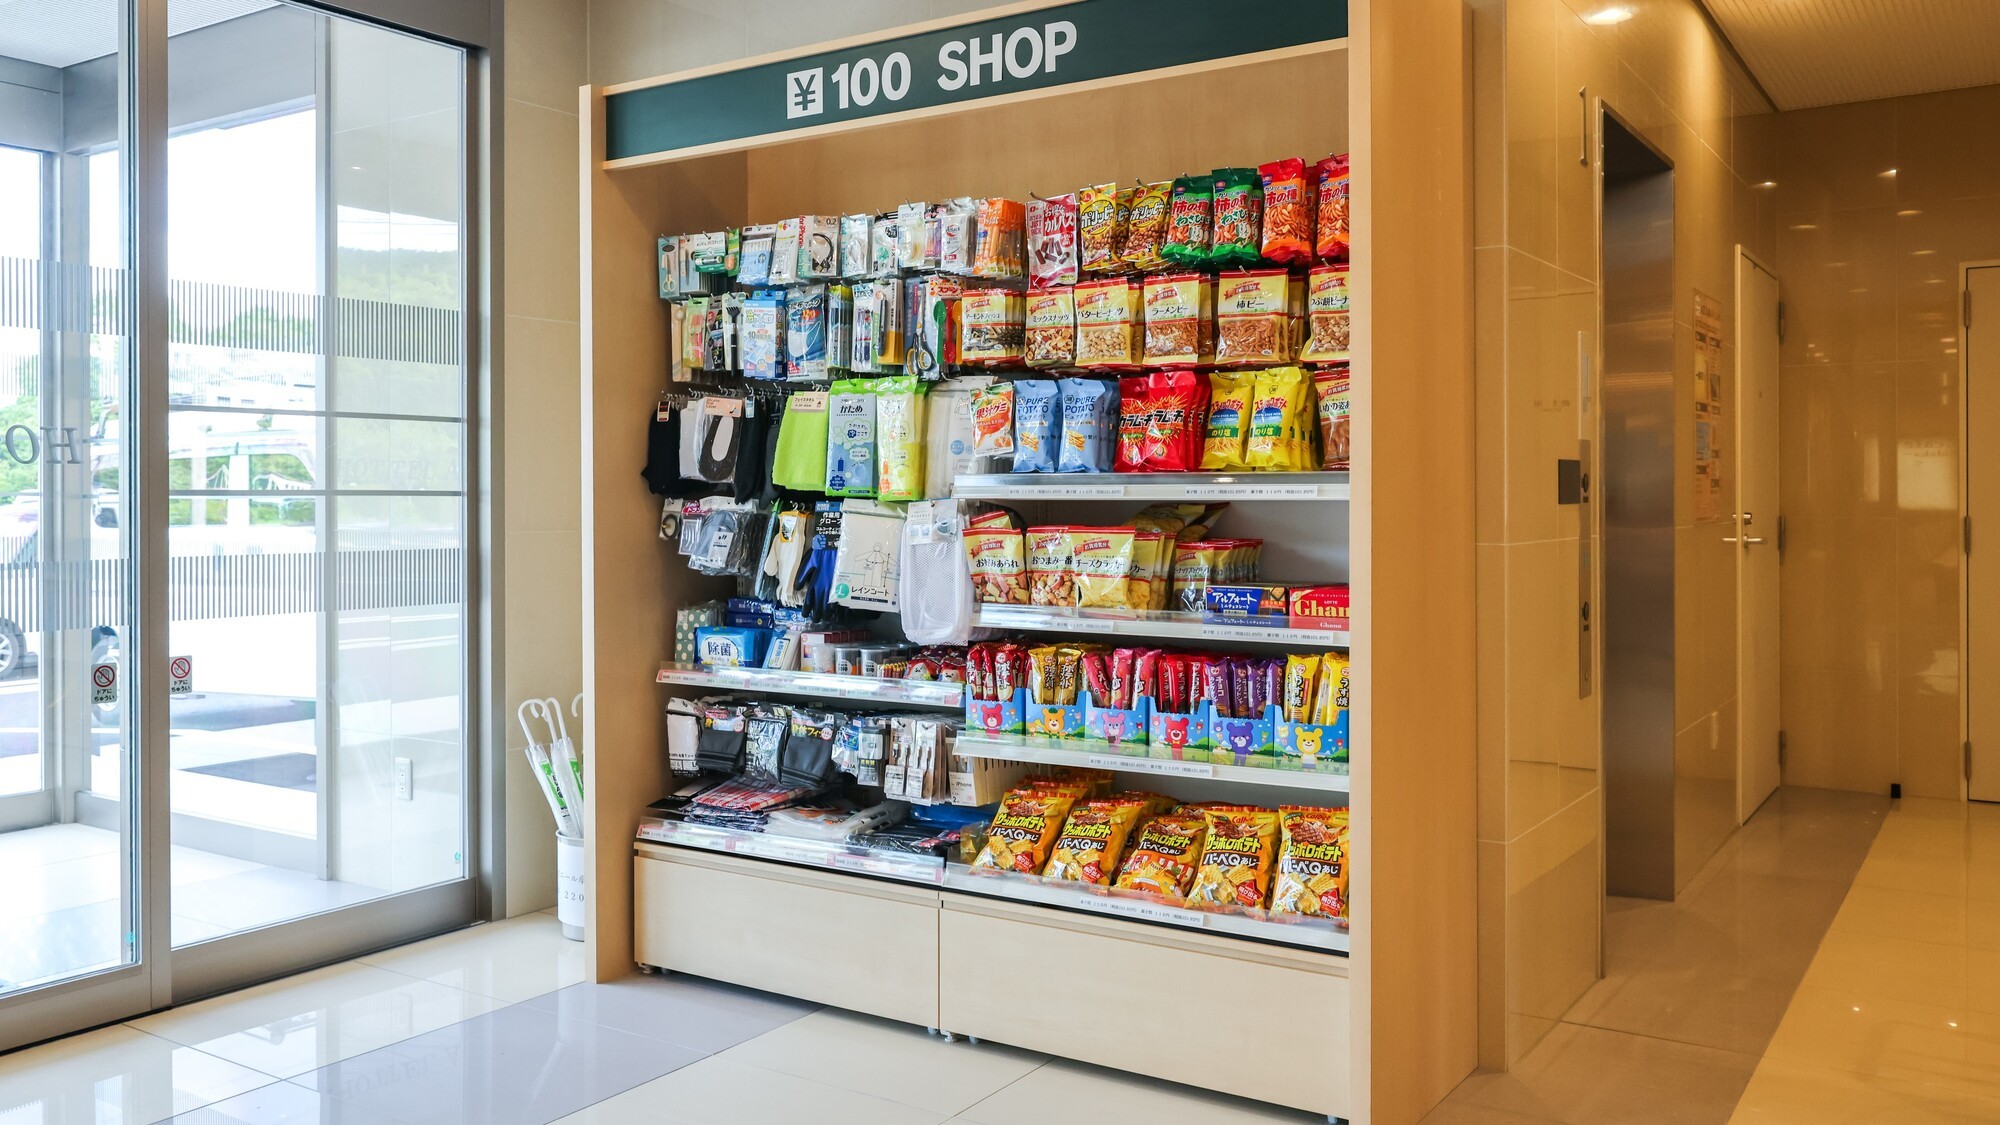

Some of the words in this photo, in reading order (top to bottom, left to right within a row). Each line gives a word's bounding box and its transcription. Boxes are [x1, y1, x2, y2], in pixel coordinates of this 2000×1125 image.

[937, 21, 1077, 91] SHOP
[1236, 300, 1264, 309] 柿ピー
[1032, 314, 1069, 323] ミックスナッツ
[1075, 396, 1097, 405] PURE
[840, 405, 863, 414] かため
[976, 402, 1007, 419] 果汁グミ
[1065, 404, 1095, 413] POTATO
[1211, 428, 1231, 437] のり塩
[1255, 427, 1274, 436] のり塩
[976, 559, 1019, 568] お好みあられ
[1031, 555, 1073, 565] おつまみ一番
[851, 585, 889, 597] レインコート
[1212, 592, 1257, 604] アルフォート
[1295, 599, 1349, 617] Ghan
[707, 641, 731, 656] 除菌
[995, 813, 1046, 831] サッポロポテト
[1063, 822, 1112, 838] サッポロポテト
[1206, 834, 1261, 853] サッポロポテト
